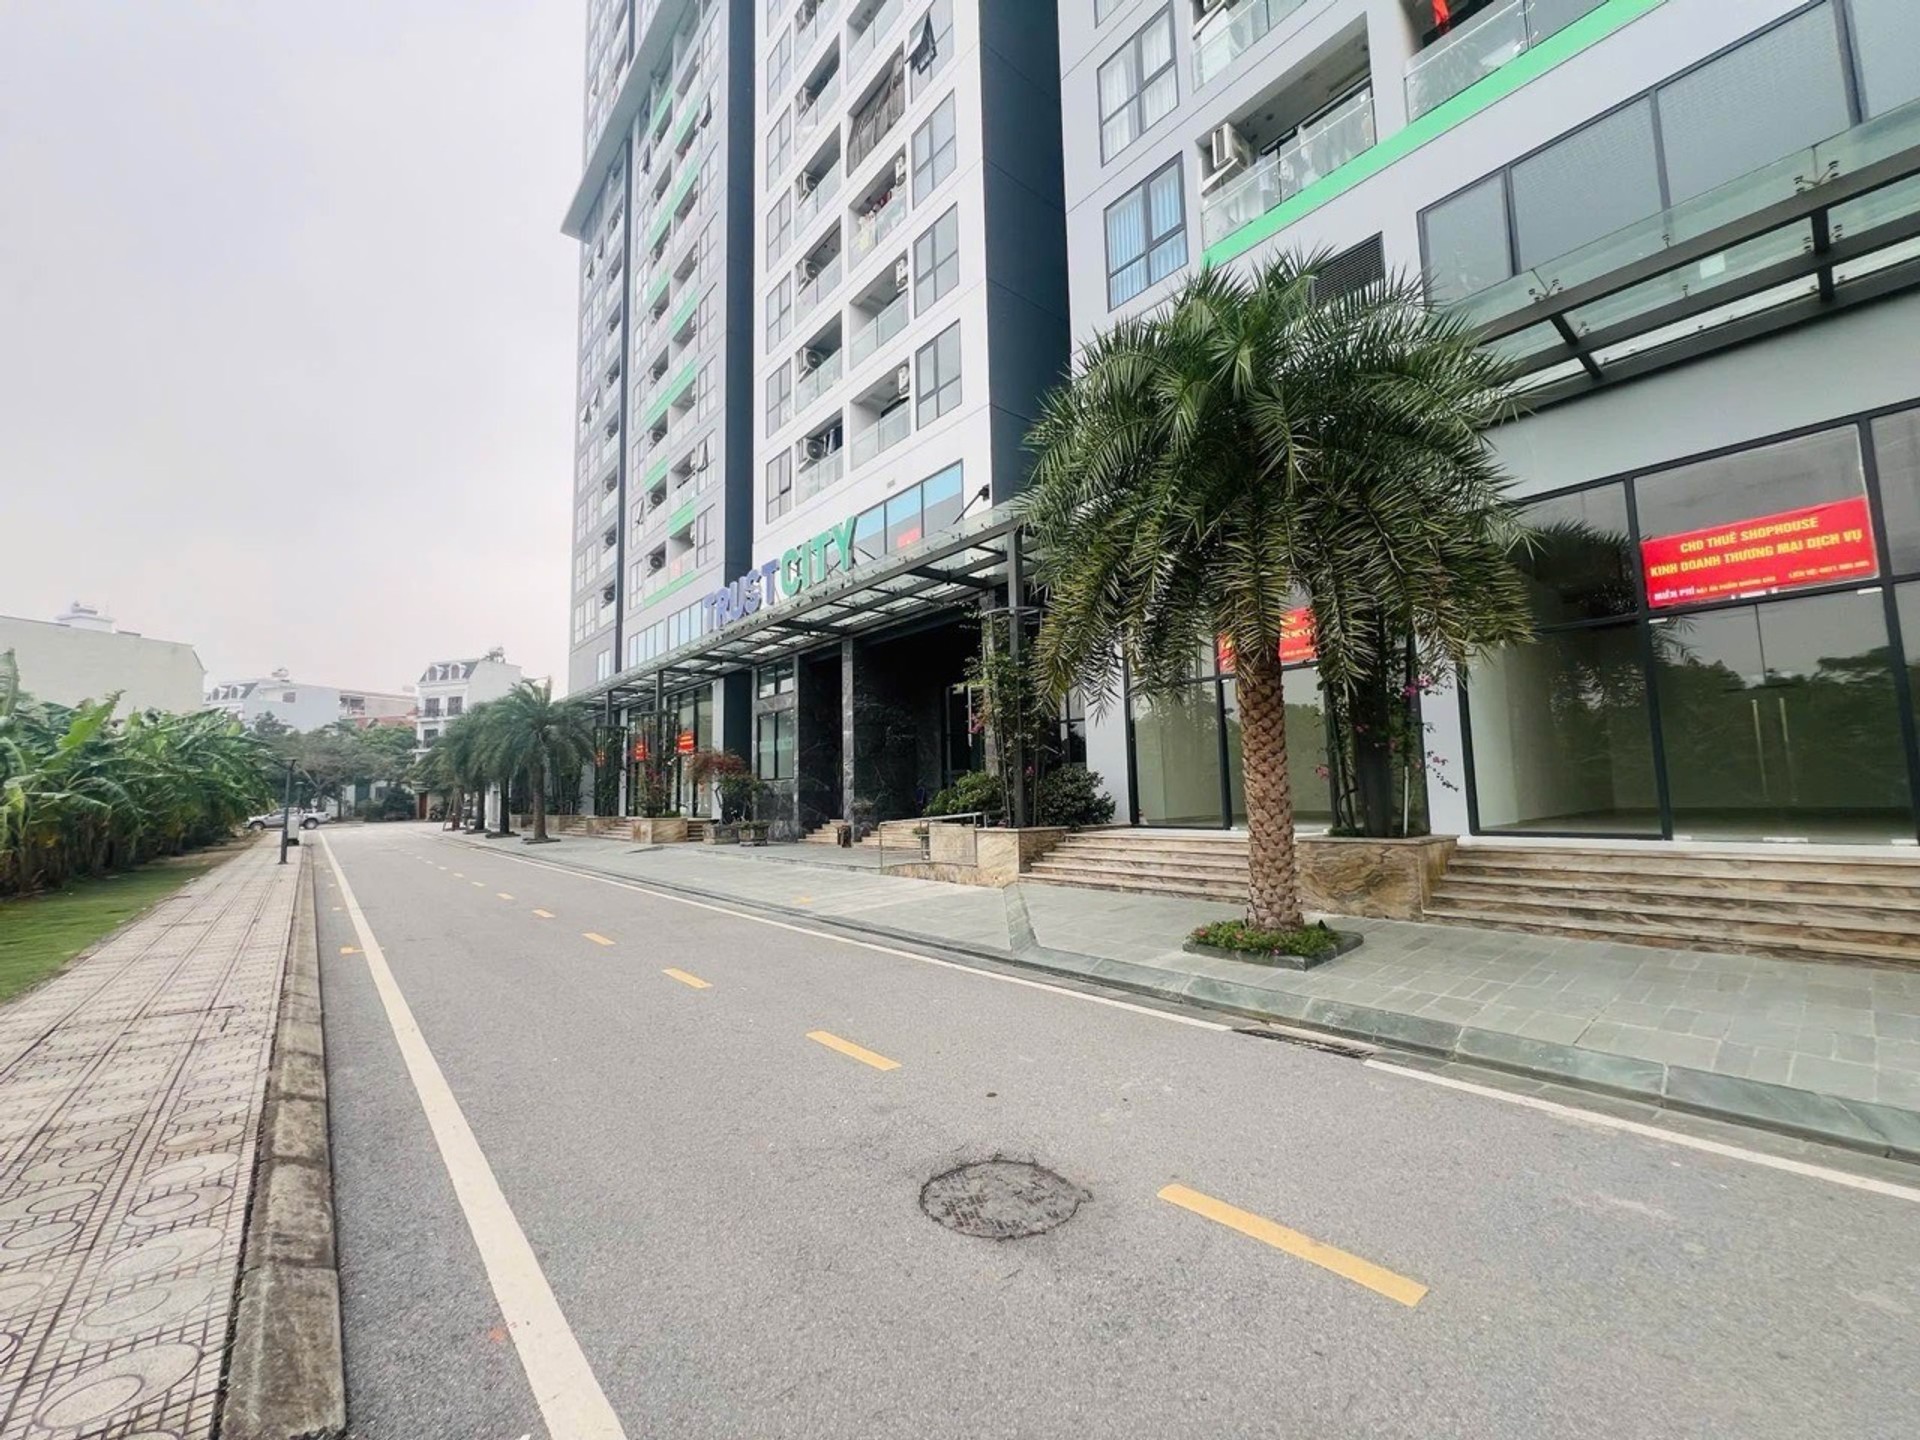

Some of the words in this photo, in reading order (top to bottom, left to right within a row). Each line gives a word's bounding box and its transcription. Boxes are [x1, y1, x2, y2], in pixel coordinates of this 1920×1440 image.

[1650, 563, 1678, 577] KINH
[1681, 555, 1720, 572] DOANH
[1777, 540, 1803, 554] MẠI
[1807, 533, 1840, 550] DỊCH
[1843, 528, 1863, 543] VỤ
[1680, 540, 1704, 553] CHO
[1708, 531, 1737, 548] THUÊ
[1740, 516, 1819, 541] SHOPHOUSE
[703, 558, 780, 632] TRUST
[780, 515, 858, 597] CITY
